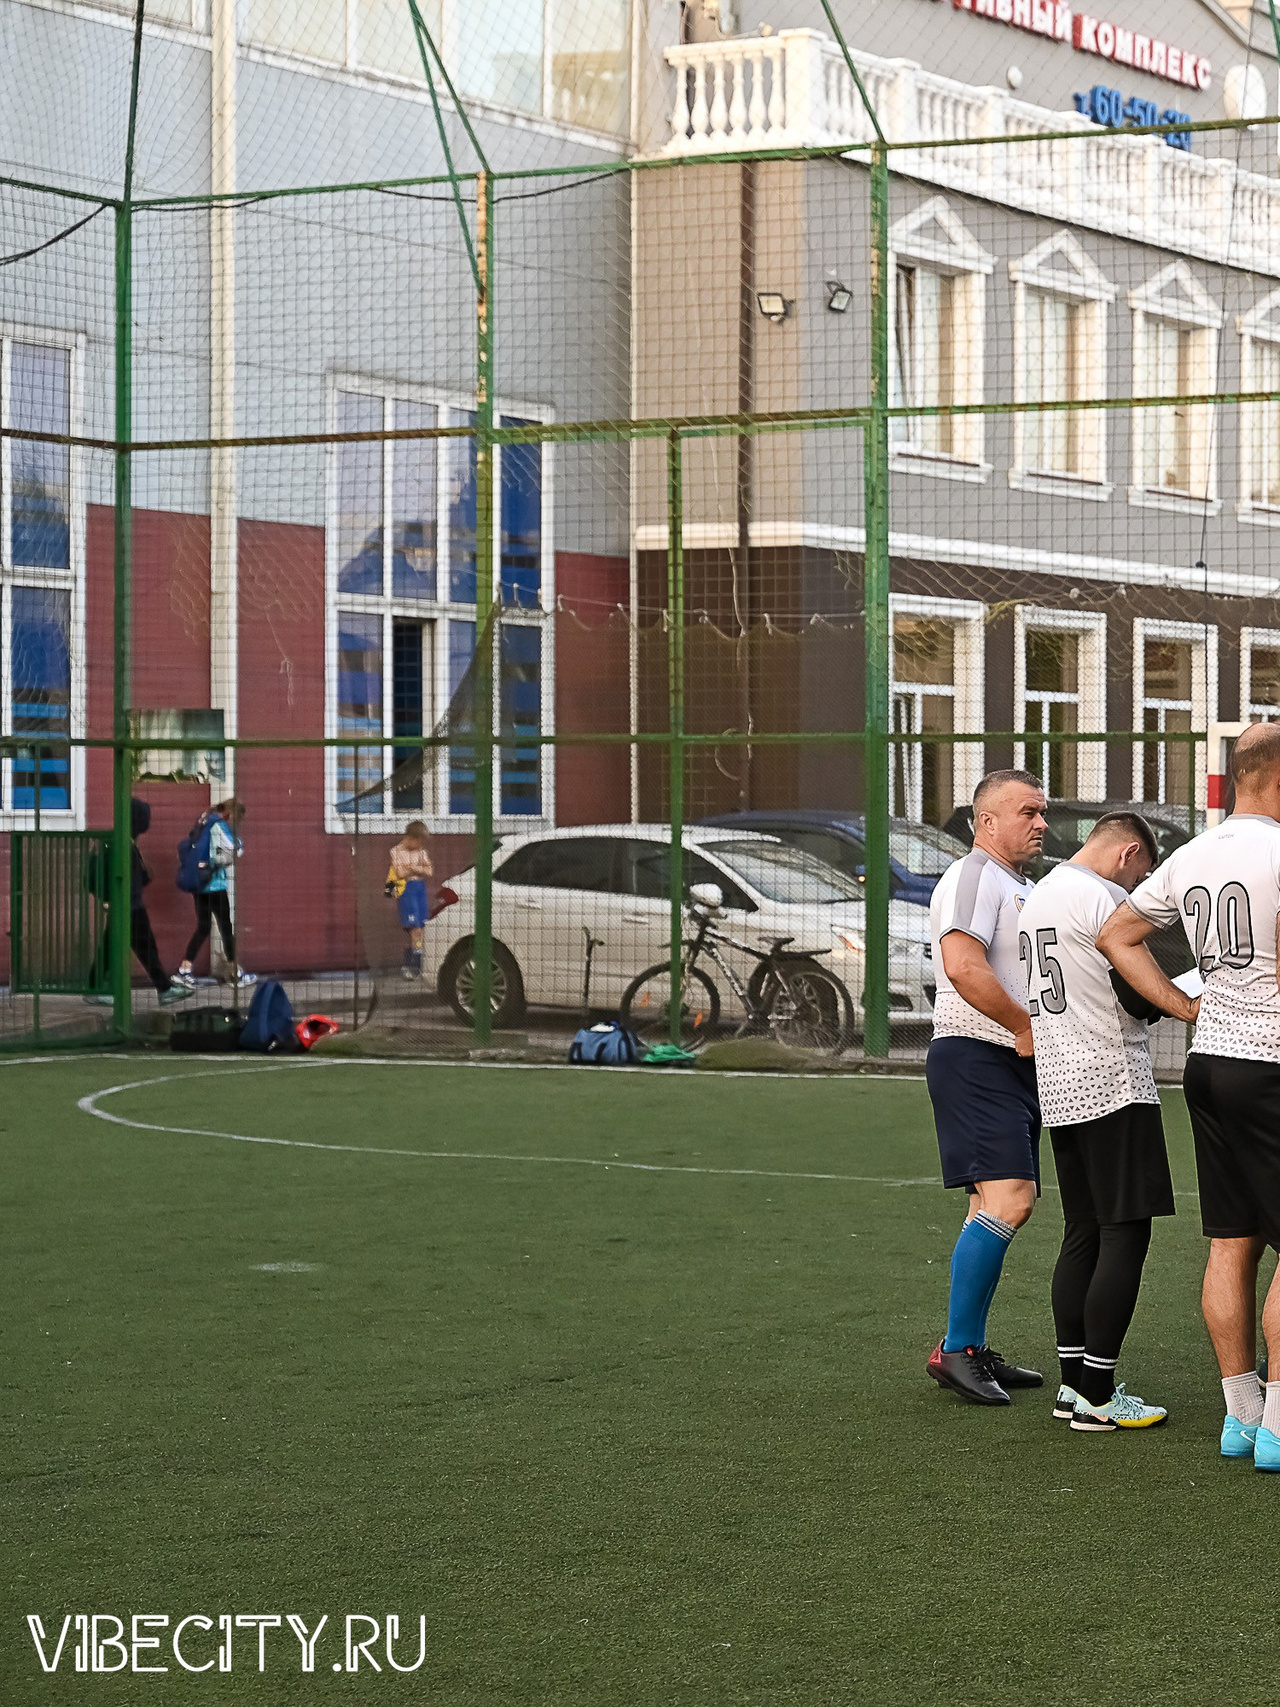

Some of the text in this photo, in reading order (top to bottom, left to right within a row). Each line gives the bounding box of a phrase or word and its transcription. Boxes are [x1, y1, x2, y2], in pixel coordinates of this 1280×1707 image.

[1073, 14, 1212, 91] КОМПЛЕКС
[1183, 880, 1255, 973] 20
[1018, 927, 1067, 1017] 25
